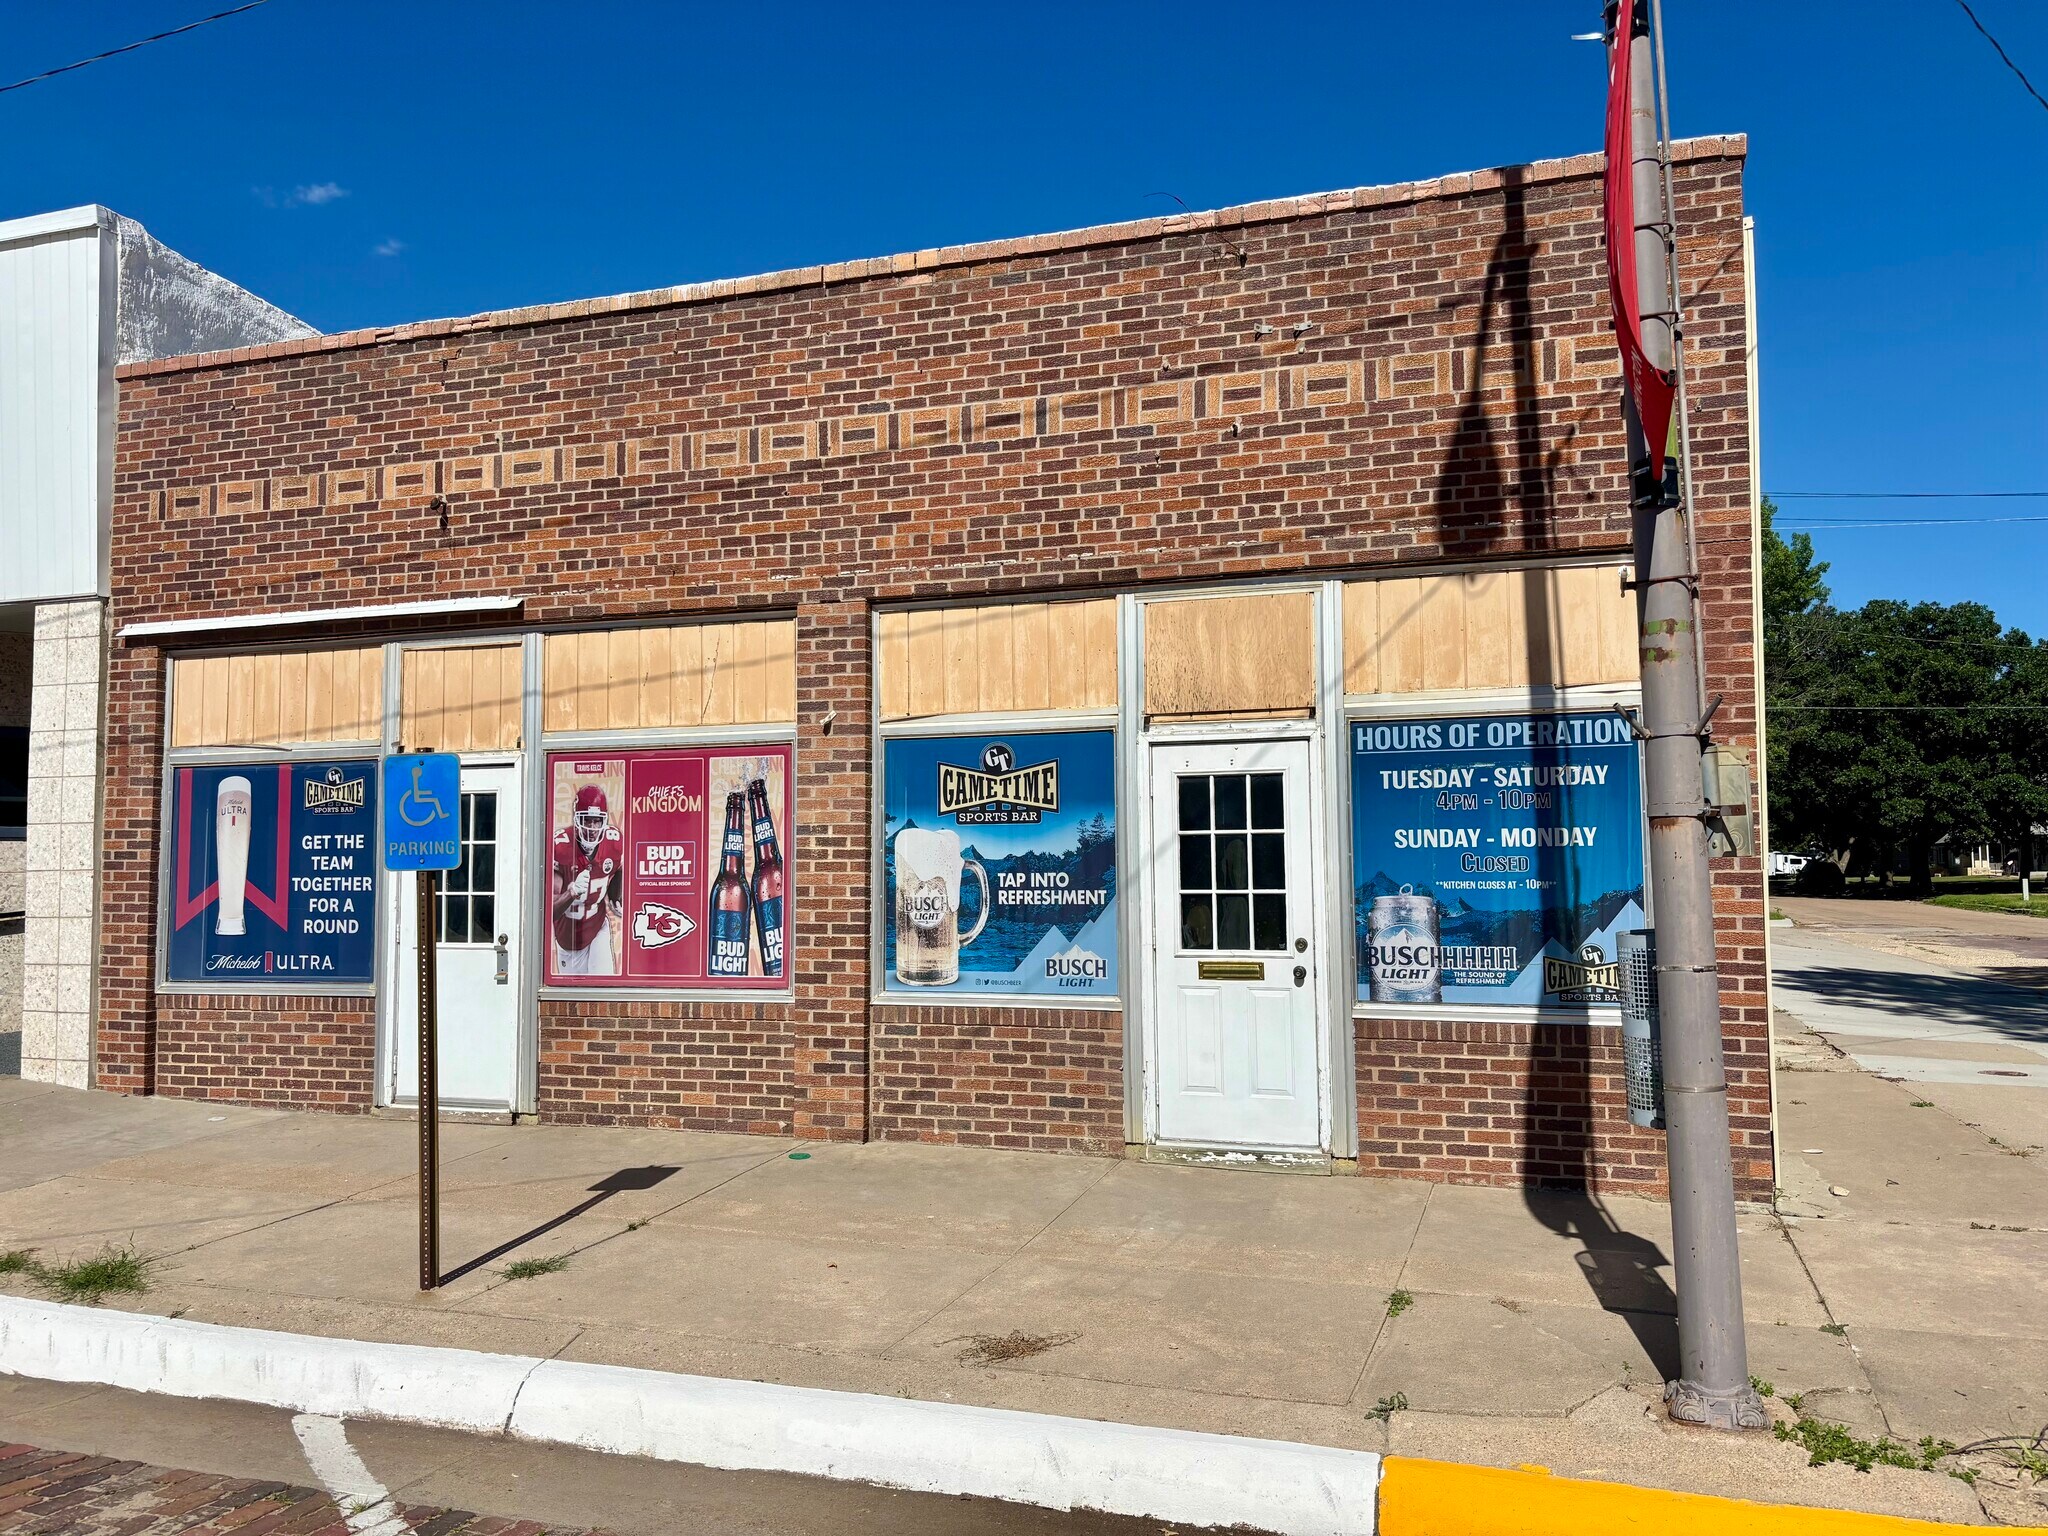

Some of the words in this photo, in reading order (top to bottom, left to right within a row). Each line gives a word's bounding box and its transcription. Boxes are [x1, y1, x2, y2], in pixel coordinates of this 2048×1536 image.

[1356, 724, 1442, 750] HOURS
[1449, 723, 1480, 747] OF
[1487, 718, 1632, 747] OPERATION
[985, 748, 1009, 772] GT
[1380, 769, 1474, 790] TUESDAY
[1493, 765, 1609, 788] SATURDAY
[307, 781, 363, 805] GAMETIME
[648, 785, 684, 797] CHIEFS
[942, 766, 1054, 808] GAMETIME
[632, 795, 702, 814] KINGDOM
[1436, 790, 1478, 810] 4PM
[1498, 789, 1552, 810] 10PM
[221, 805, 247, 816] ULTRA
[958, 812, 1008, 822] SPORTS
[1011, 811, 1038, 821] BAR
[754, 828, 775, 842] LIGHT
[755, 822, 771, 833] BUD
[302, 835, 329, 850] GET
[334, 834, 365, 849] THE
[727, 834, 743, 842] BUD
[1394, 828, 1481, 849] SUNDAY
[1501, 827, 1598, 848] MONDAY
[389, 840, 456, 856] PARKING
[646, 845, 685, 860] BUD
[725, 842, 744, 851] LIGHT
[311, 856, 353, 870] TEAM
[639, 860, 691, 876] LIGHT
[292, 877, 372, 891] TOGETHER
[997, 872, 1028, 888] TAP
[1031, 872, 1069, 888] INTO
[1477, 880, 1506, 889] CLOSES
[1507, 881, 1516, 889] AT
[309, 898, 339, 913] FOR
[342, 898, 355, 913] A
[905, 896, 949, 912] BUSCH
[998, 889, 1107, 906] REFRESHMENT
[914, 912, 941, 920] LIGHT
[303, 919, 359, 934] ROUND
[647, 912, 681, 938] KC
[765, 926, 782, 946] BU
[717, 940, 745, 957] BUD
[763, 943, 782, 963] LIG
[1581, 946, 1602, 965] GT
[206, 954, 263, 970] Michelob
[276, 955, 334, 970] ULTRA
[711, 955, 747, 972] LIGHT
[1046, 957, 1108, 979] BUSCH
[1381, 968, 1430, 980] LIGHT
[1455, 977, 1505, 985] REFRESHMENT
[1547, 960, 1619, 990] GAMETI
[1058, 978, 1094, 987] LIGHT
